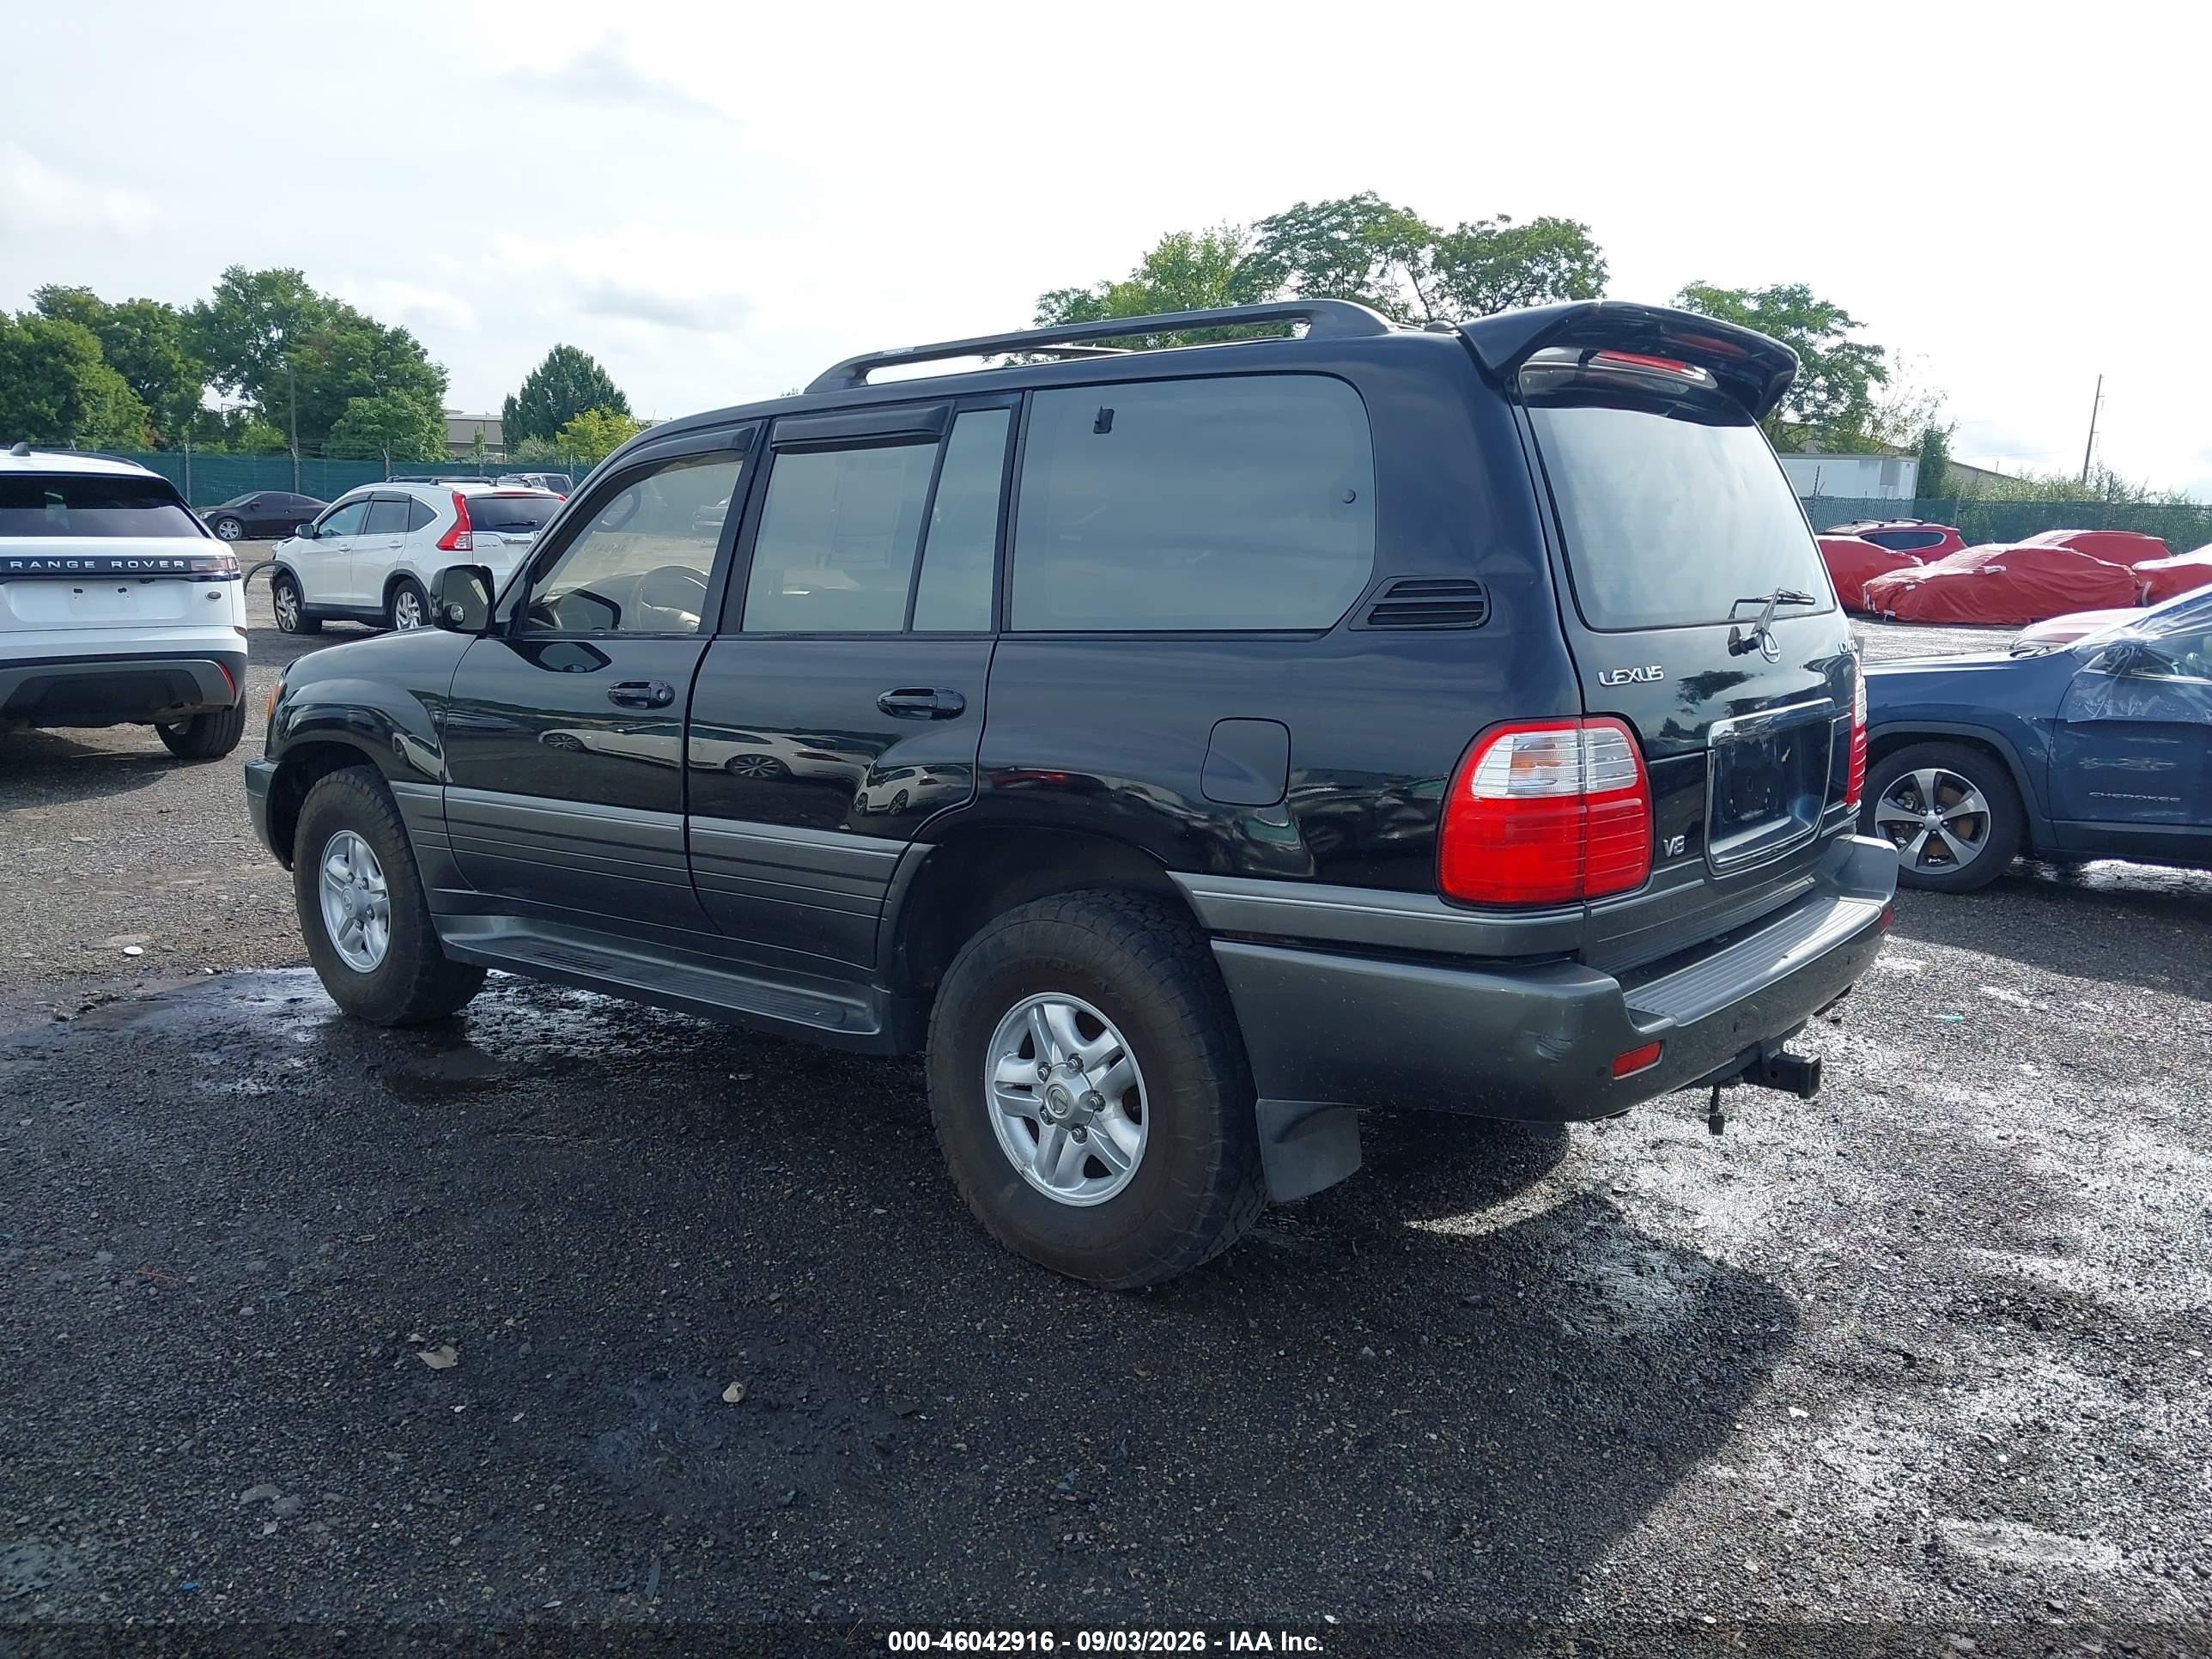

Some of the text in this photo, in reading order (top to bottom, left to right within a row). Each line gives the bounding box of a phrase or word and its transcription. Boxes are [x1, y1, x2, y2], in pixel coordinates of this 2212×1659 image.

[9, 560, 185, 569] RANGE ROVER
[1598, 665, 1664, 686] LEXUS
[1662, 835, 1685, 857] V8
